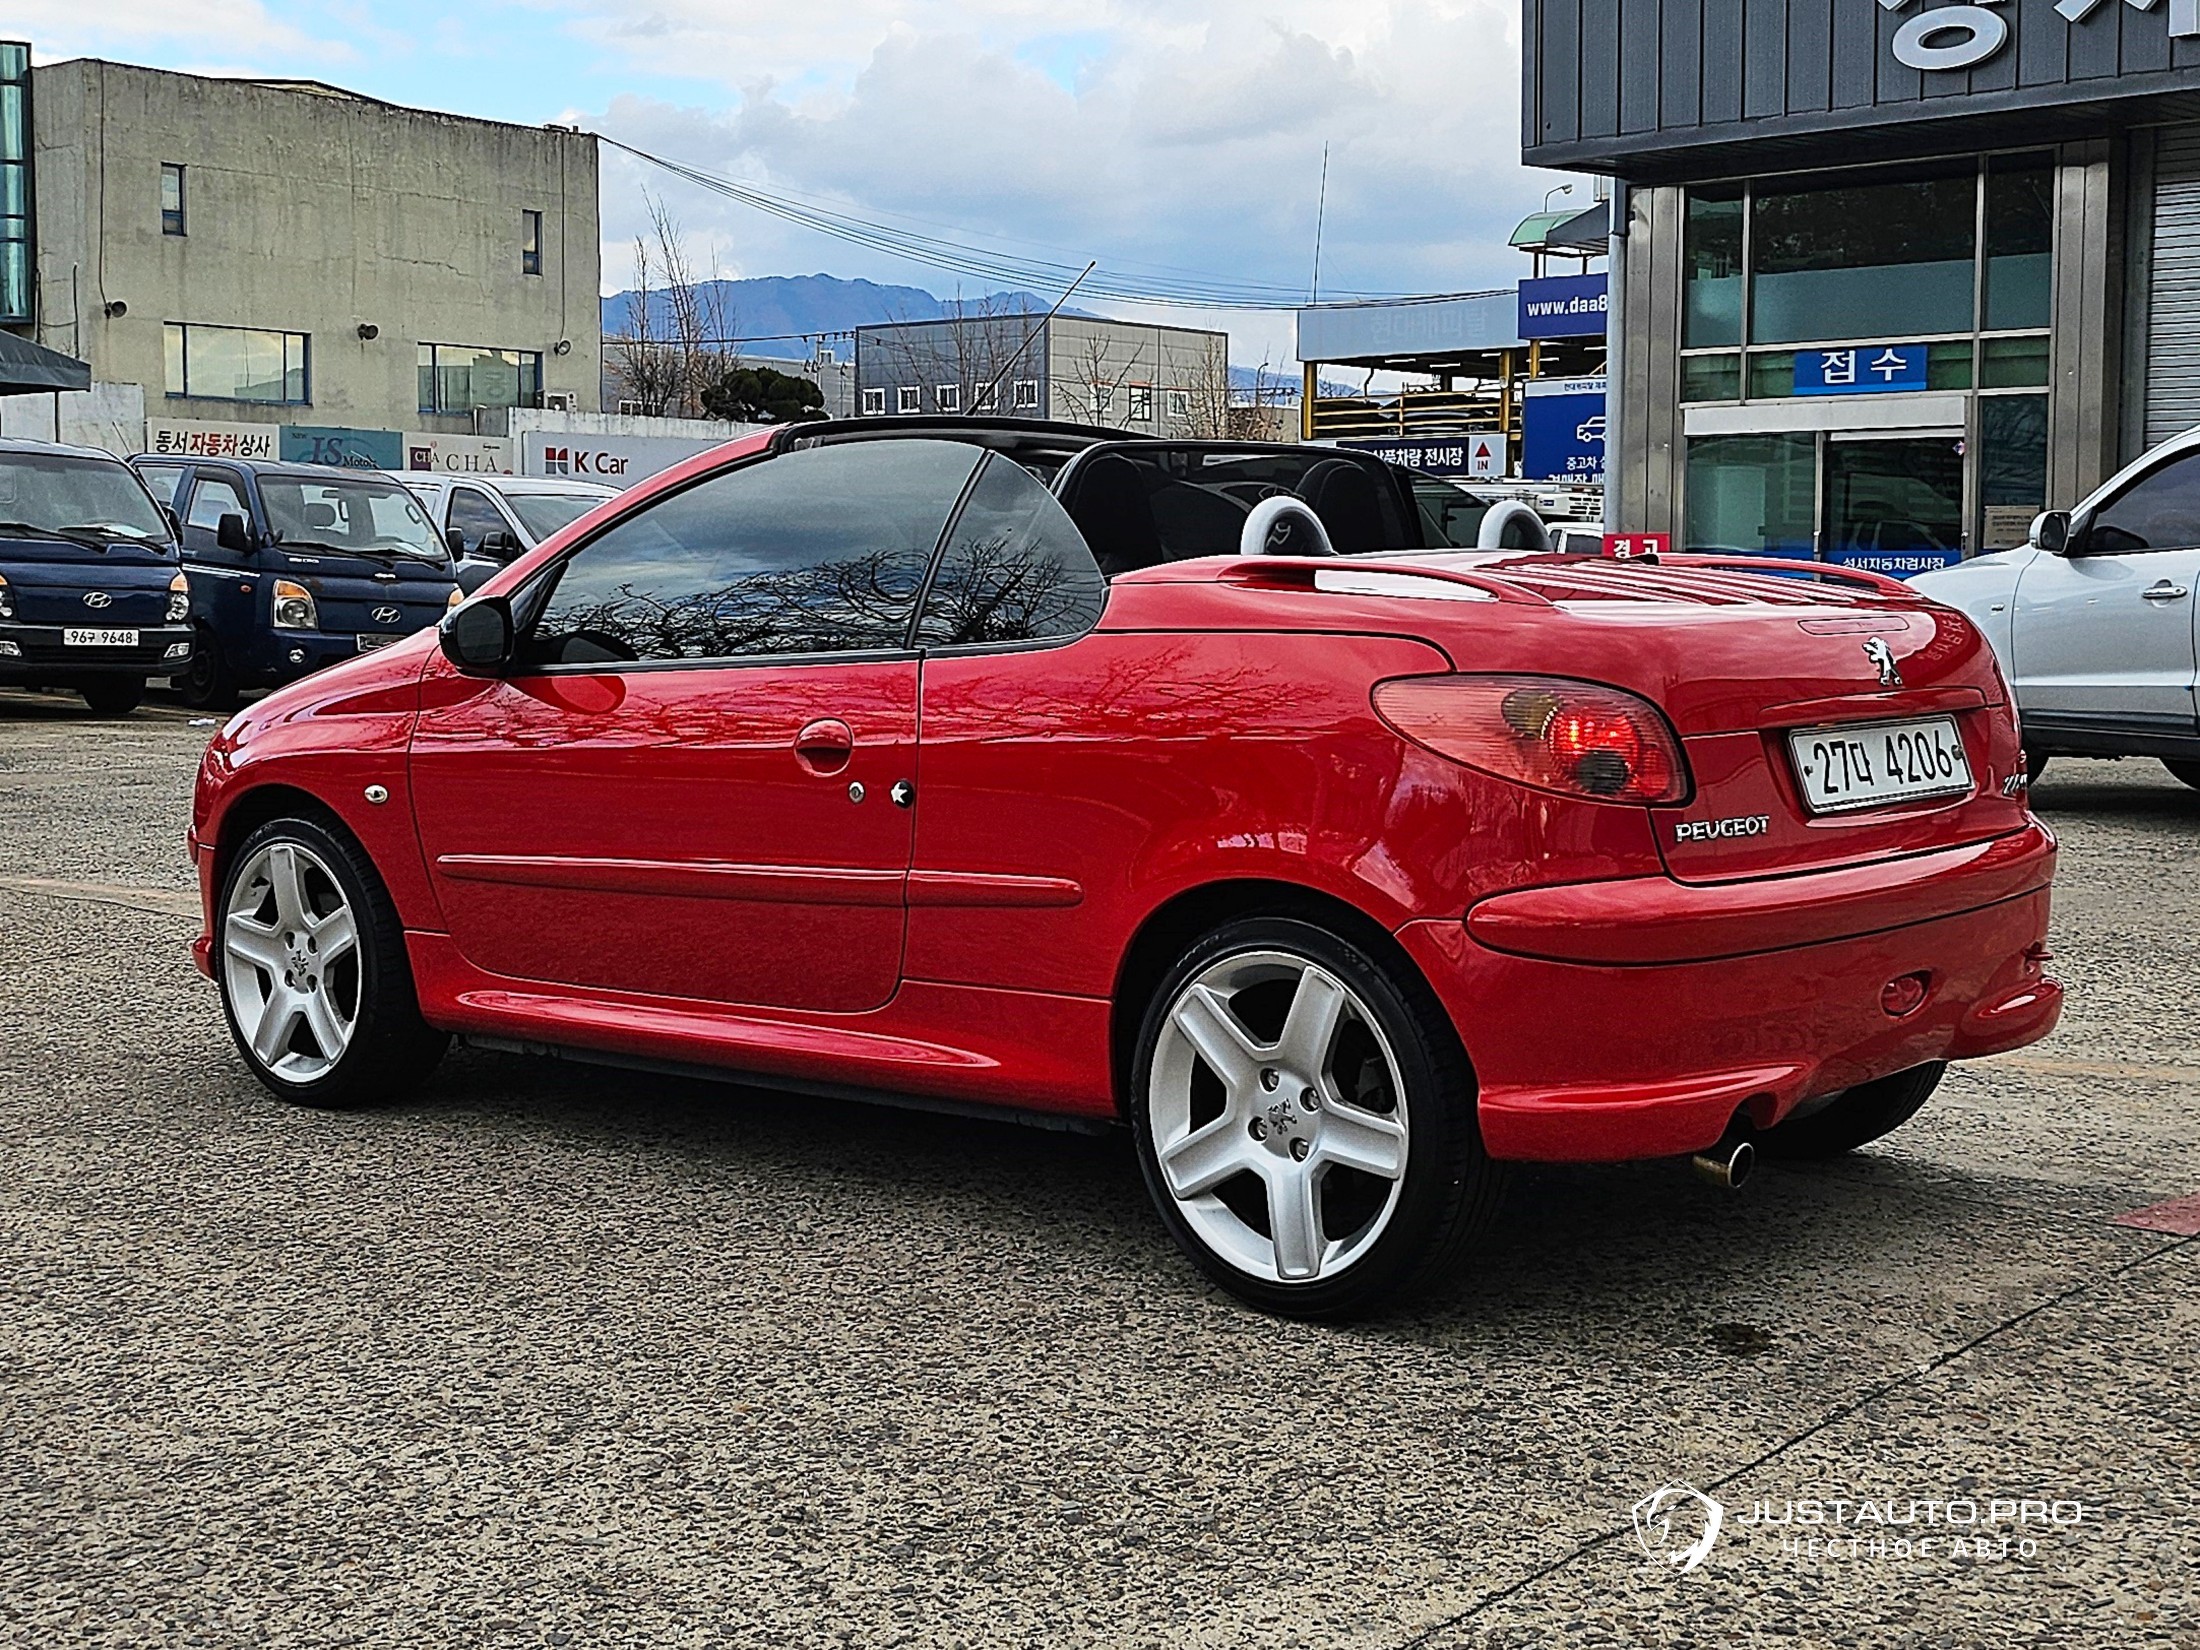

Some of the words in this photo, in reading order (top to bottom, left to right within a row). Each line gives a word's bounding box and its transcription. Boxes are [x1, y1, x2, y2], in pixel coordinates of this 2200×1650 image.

[1821, 348, 1907, 384] 접수
[156, 431, 270, 457] 동서자동차상사
[446, 454, 498, 472] CHA
[575, 452, 589, 473] K
[595, 453, 629, 475] Car
[1425, 447, 1463, 466] 전시장
[1477, 460, 1489, 471] IN
[1566, 456, 1597, 470] 중고차
[1843, 557, 1945, 571] 성서자동차검사장
[71, 630, 96, 643] 96구
[101, 631, 133, 644] 9648
[1814, 740, 1874, 795] 27다
[1885, 729, 1953, 785] 4206
[1676, 816, 1769, 842] PEUGEOT
